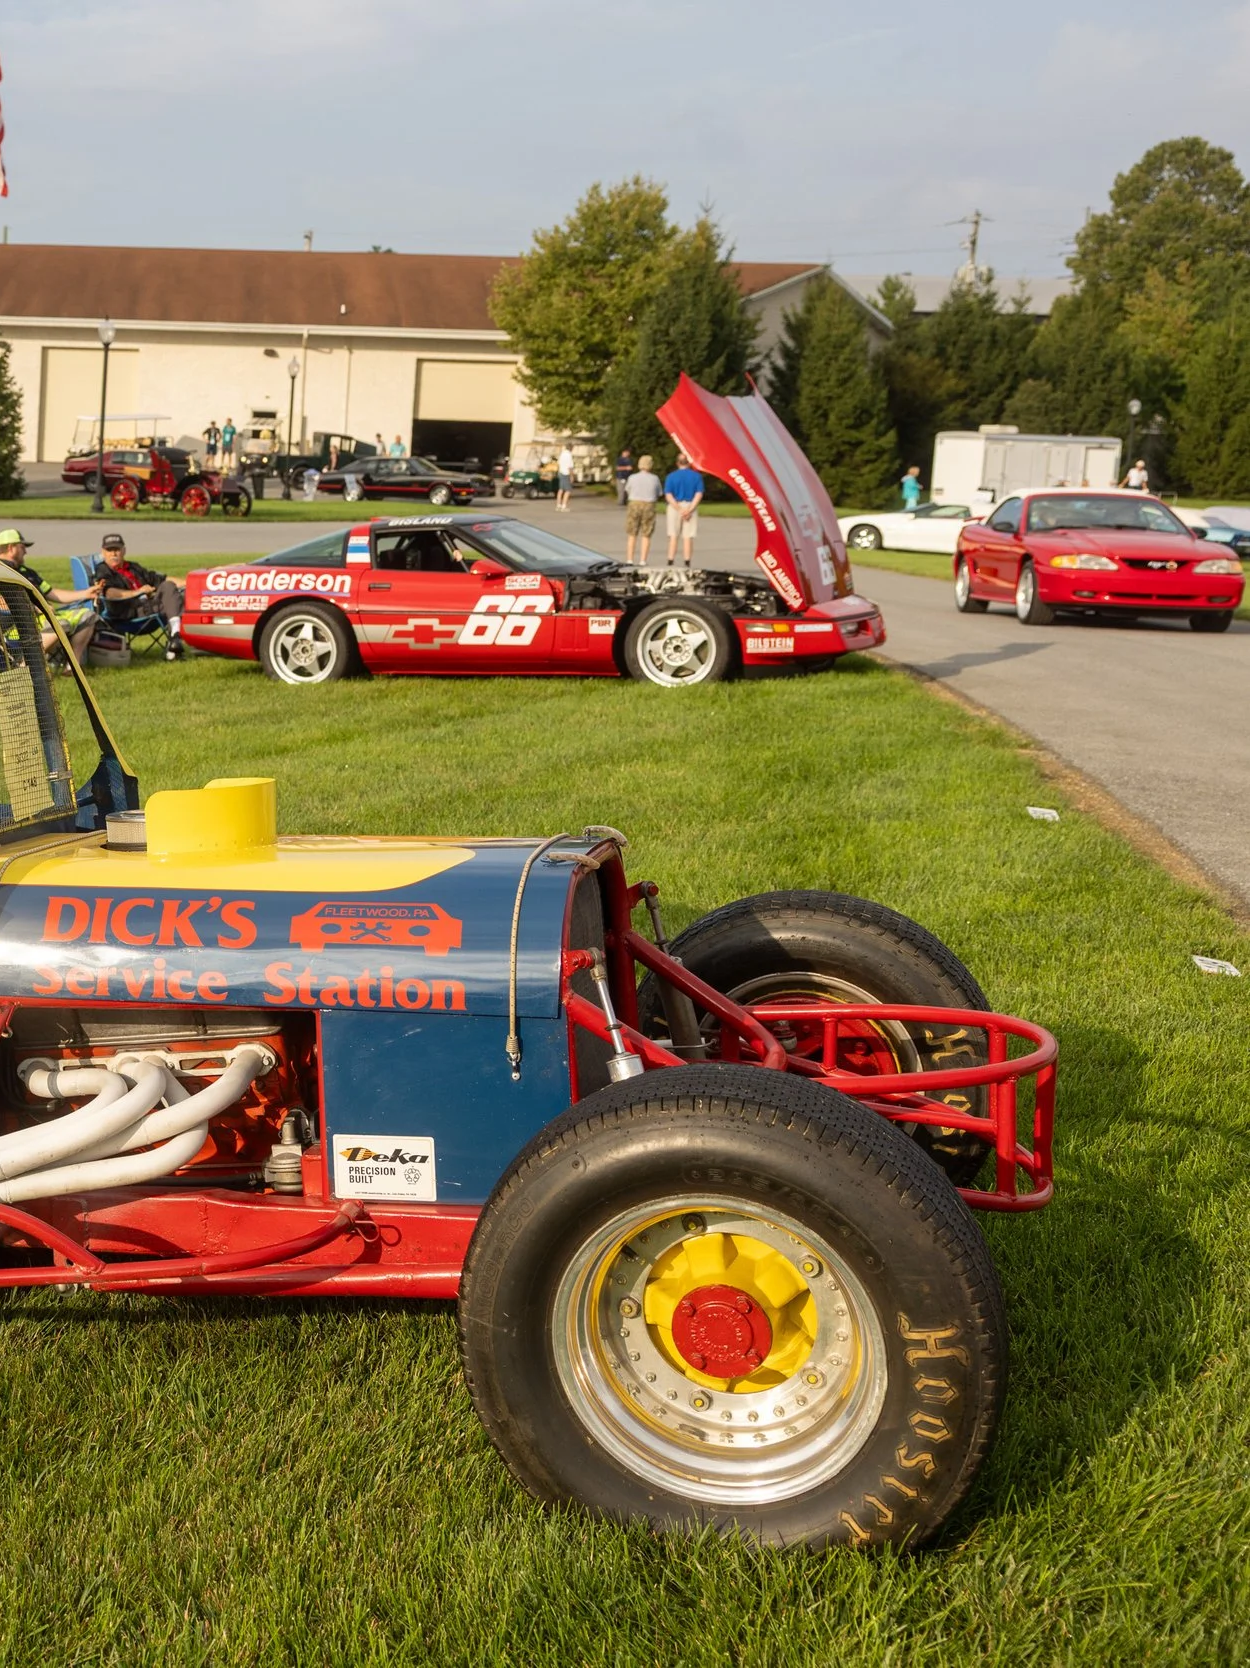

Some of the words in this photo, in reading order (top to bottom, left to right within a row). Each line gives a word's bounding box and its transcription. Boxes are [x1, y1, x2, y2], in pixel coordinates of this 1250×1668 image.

[727, 468, 777, 532] GOODYEAR
[205, 569, 352, 593] Genderson
[761, 550, 778, 571] MID
[772, 568, 803, 609] AMERICA
[200, 602, 268, 610] CHALLENGE
[211, 595, 269, 603] CORVETTE
[457, 595, 554, 646] 66
[590, 619, 612, 628] PBR
[747, 637, 794, 648] BILSTEIN
[413, 909, 430, 917] PA
[41, 896, 258, 949] DICK'S
[32, 958, 228, 1002] Service
[263, 963, 467, 1012] Station
[340, 1147, 429, 1165] Deka
[349, 1167, 396, 1176] PRECISION
[349, 1175, 373, 1184] BUILT
